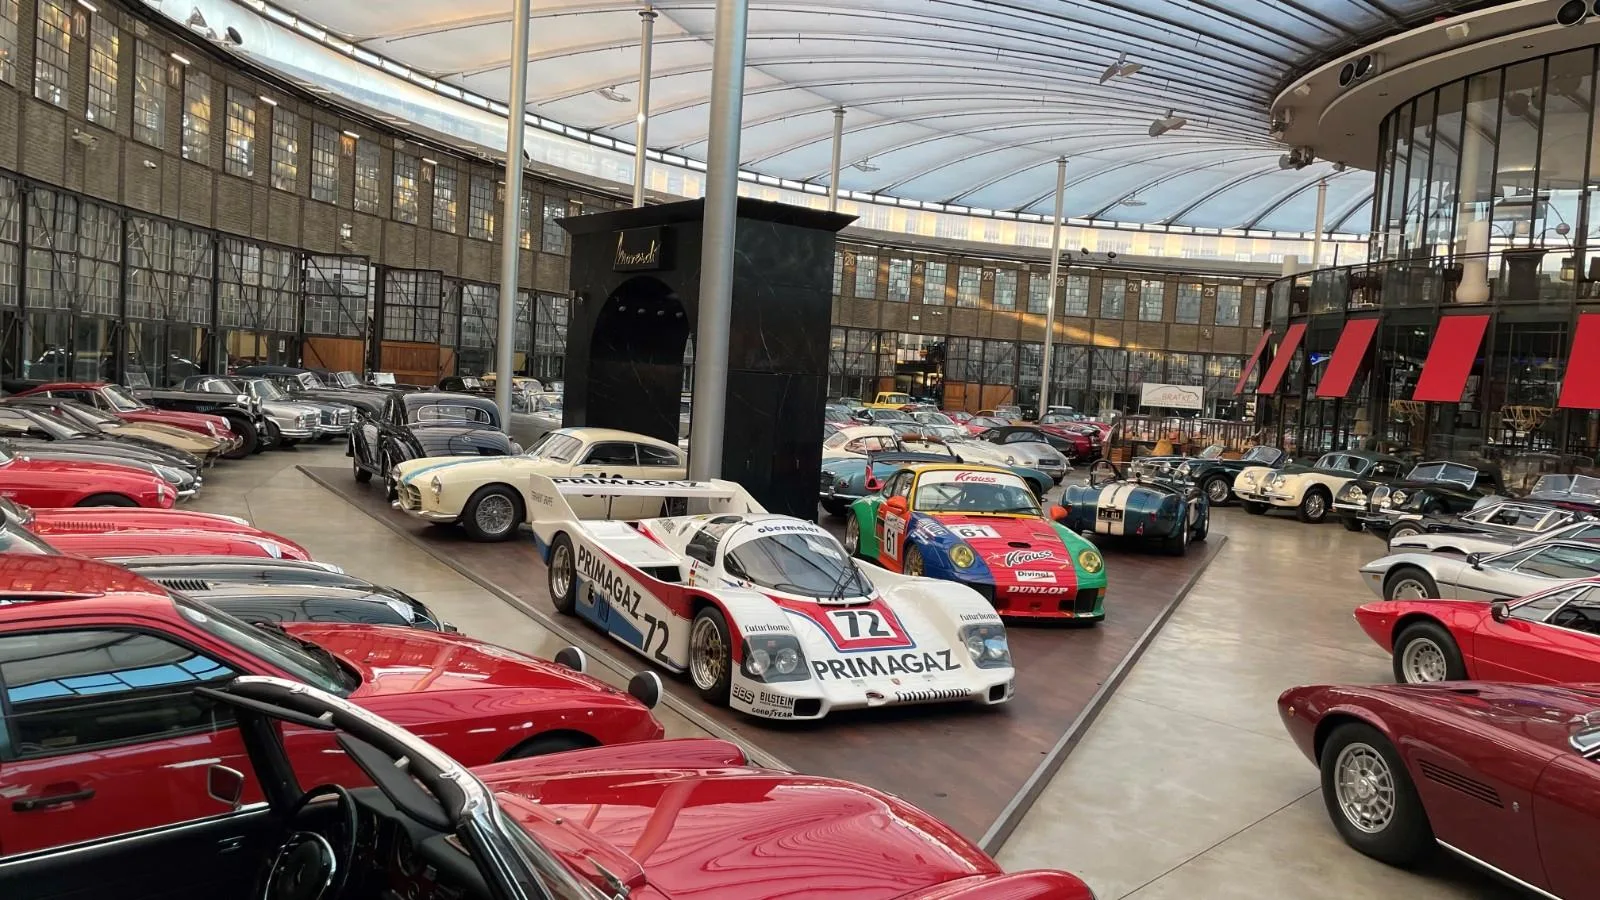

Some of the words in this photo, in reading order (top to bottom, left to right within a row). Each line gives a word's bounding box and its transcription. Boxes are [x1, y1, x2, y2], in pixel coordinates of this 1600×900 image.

[74, 12, 86, 37] 10
[844, 255, 855, 266] 20
[914, 263, 923, 273] 21
[983, 271, 994, 281] 22
[1204, 288, 1215, 297] 25
[954, 472, 997, 483] Krauss
[758, 523, 819, 533] obermaier
[959, 527, 990, 538] 61
[886, 528, 895, 555] 61
[1005, 550, 1053, 567] Krauss
[577, 544, 642, 619] PRIMAGAZ
[1007, 586, 1069, 595] DUNLOP
[959, 612, 998, 622] futurhome
[744, 622, 791, 633] futurhome
[834, 611, 889, 637] 72
[643, 615, 670, 662] 72
[811, 649, 961, 680] PRIMAGAZ
[760, 691, 793, 705] BILSTEIN
[895, 687, 971, 701] futurhome
